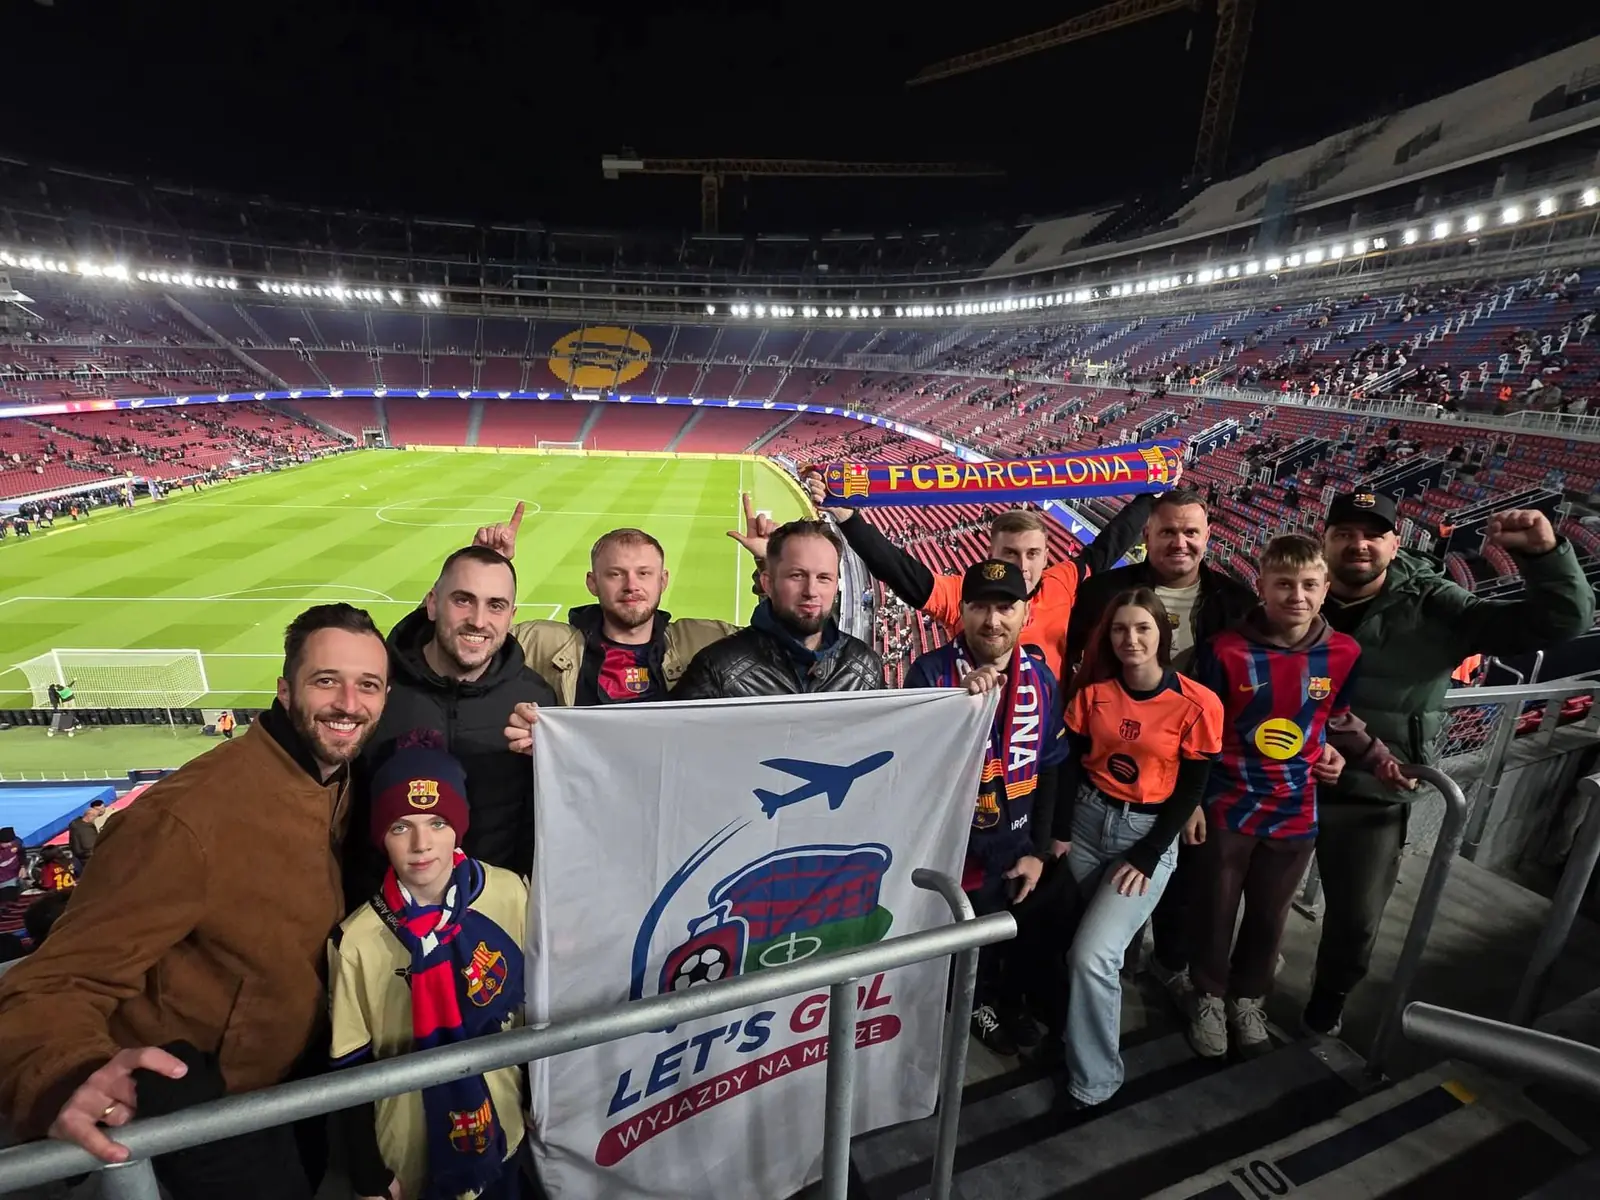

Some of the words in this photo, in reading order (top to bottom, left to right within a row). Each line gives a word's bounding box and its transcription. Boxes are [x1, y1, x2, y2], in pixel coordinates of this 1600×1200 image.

[1010, 813, 1029, 832] RÇA
[606, 1010, 776, 1118] LET'S
[789, 973, 892, 1034] GL
[617, 1070, 748, 1148] WYJAZDY
[758, 1055, 792, 1078] NA
[803, 1023, 882, 1062] MEZE
